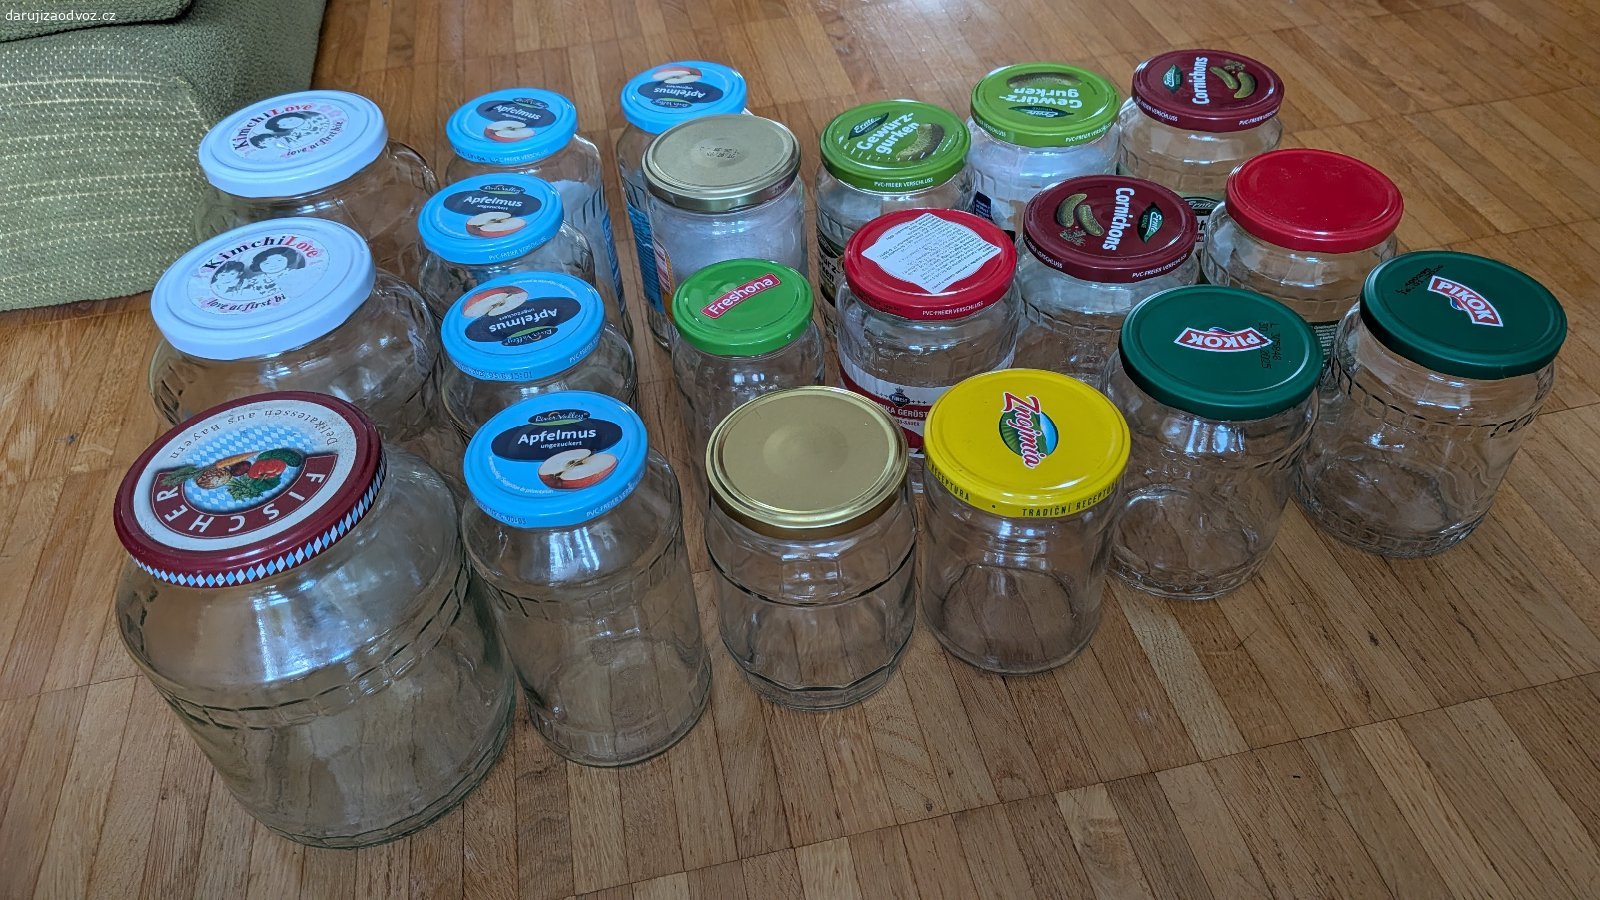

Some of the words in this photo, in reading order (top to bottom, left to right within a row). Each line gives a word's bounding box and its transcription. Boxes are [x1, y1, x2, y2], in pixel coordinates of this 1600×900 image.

[1188, 56, 1211, 105] Cornichons
[653, 87, 706, 99] Apfelmus
[998, 94, 1083, 109] Gewürz-
[1014, 87, 1080, 98] gurken
[493, 104, 542, 120] Apfelmus
[856, 112, 914, 151] Gewürz-
[876, 122, 920, 154] gurken
[463, 196, 523, 208] Apfelmus
[1102, 187, 1135, 251] Cornichons
[206, 299, 228, 311] love
[229, 302, 241, 312] at
[240, 298, 272, 313] first
[708, 276, 774, 316] Freshona
[1437, 280, 1495, 323] PIKOK
[488, 308, 558, 333] Apfelmus
[1188, 332, 1261, 348] PIKOK
[227, 411, 256, 425] aus
[264, 408, 339, 447] Delikatessen
[557, 411, 585, 424] Valley
[517, 428, 598, 446] Apfelmus
[1002, 391, 1047, 469] Znojmia
[169, 424, 221, 460] Bayern
[540, 440, 583, 450] ungezuckert
[930, 463, 969, 501] RECEPTURA
[156, 472, 327, 533] FISCHER
[1022, 502, 1071, 517] TRADIČNÍ
